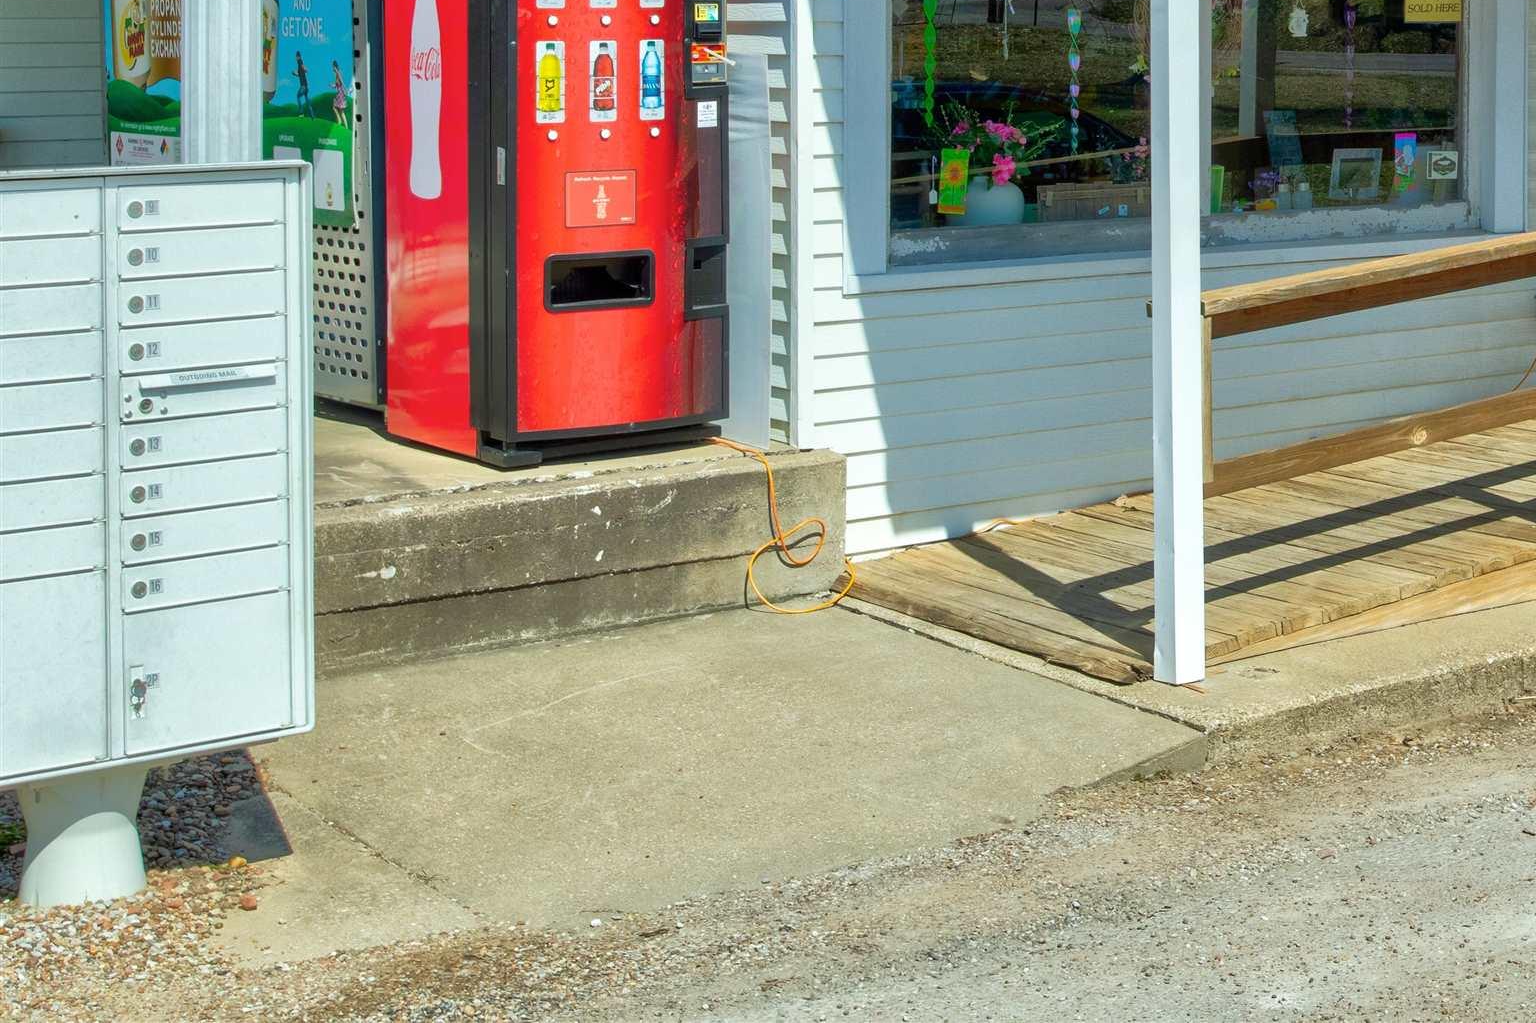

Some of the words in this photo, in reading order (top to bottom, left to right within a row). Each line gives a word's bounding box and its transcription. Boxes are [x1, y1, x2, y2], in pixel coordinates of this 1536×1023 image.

[1408, 3, 1433, 13] SOLD
[1435, 3, 1460, 13] HERE
[150, 20, 182, 37] CYLINDE
[282, 17, 301, 37] GET
[150, 39, 182, 58] EXCHAN
[148, 248, 158, 262] 10
[148, 296, 158, 308] 11
[148, 343, 158, 356] 12
[218, 369, 238, 378] MAIL
[149, 438, 160, 451] 13
[149, 485, 160, 498] 14
[150, 531, 160, 545] 15
[150, 580, 161, 593] 16
[146, 673, 158, 687] 2P
